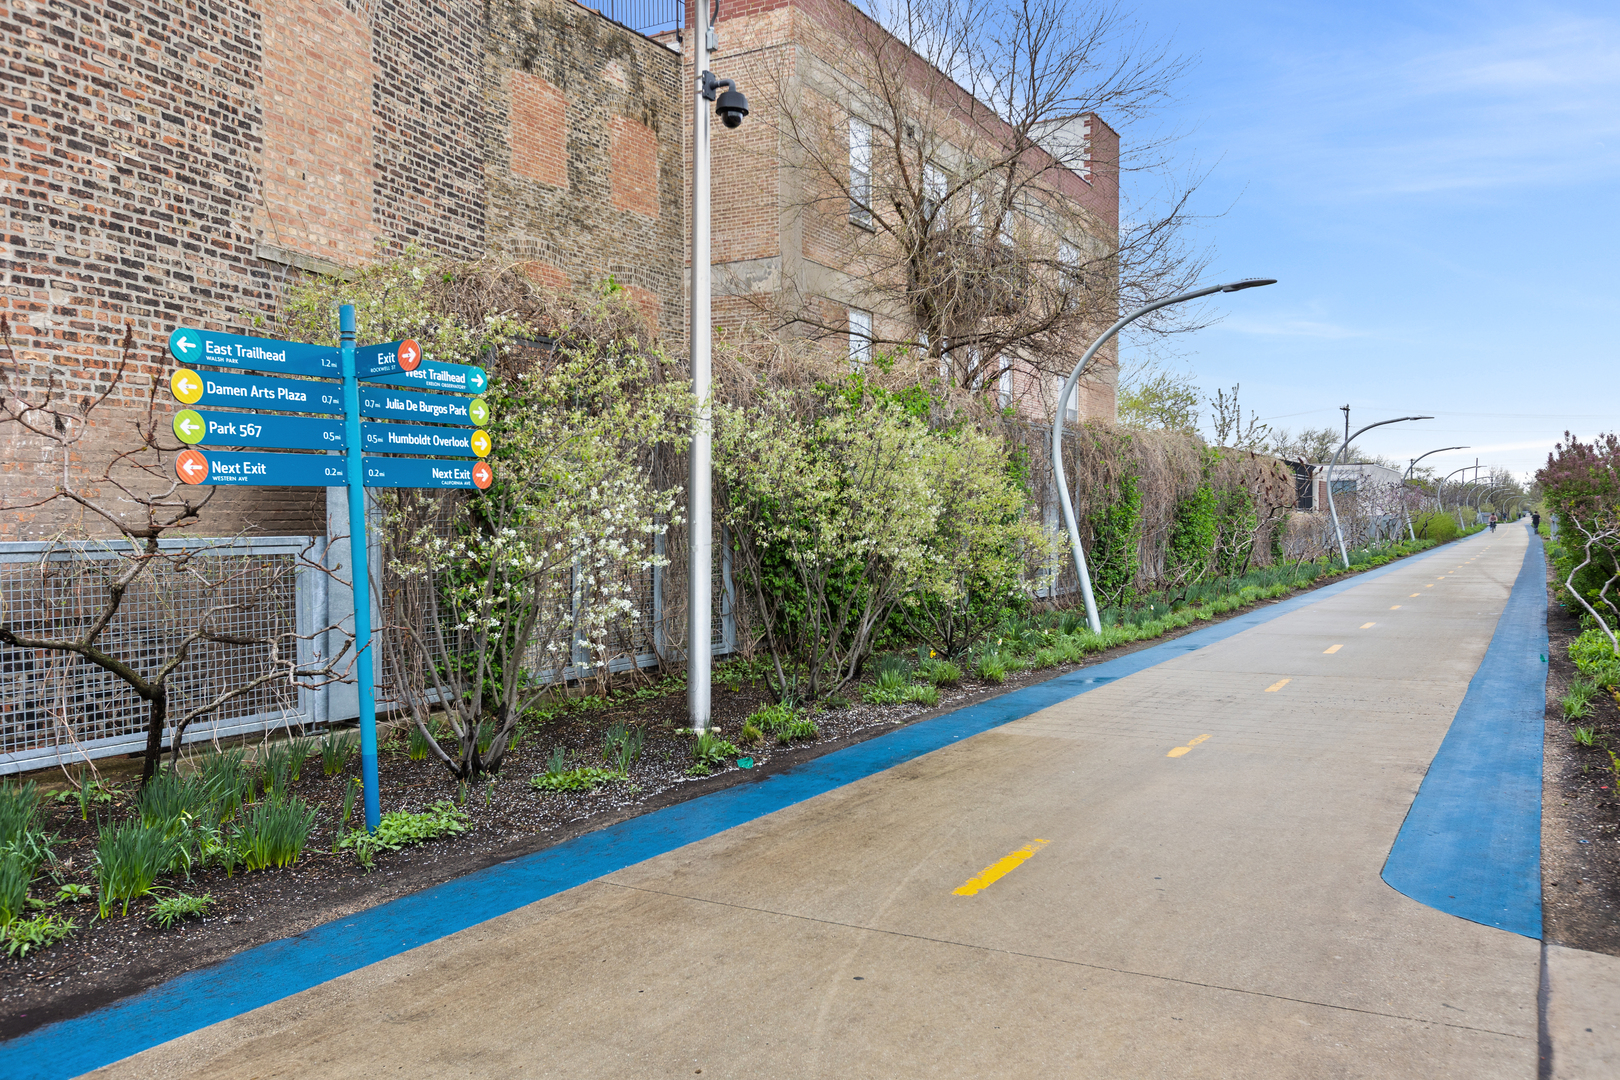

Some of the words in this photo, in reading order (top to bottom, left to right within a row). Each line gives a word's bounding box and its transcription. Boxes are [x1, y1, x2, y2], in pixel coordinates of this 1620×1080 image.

[206, 341, 232, 356] East
[235, 344, 286, 362] Trailhead
[378, 352, 395, 364] Exit
[430, 368, 466, 383] Trailhead
[207, 382, 247, 396] Damen
[251, 385, 275, 399] Arts
[278, 388, 306, 401] Plaza
[386, 398, 404, 411] Julia
[406, 401, 418, 412] De
[420, 403, 448, 416] Burgos
[449, 405, 467, 416] Park
[209, 421, 236, 435] Park
[240, 424, 262, 437] 567
[388, 433, 431, 445] Humboldt
[433, 435, 469, 448] Overlook
[212, 461, 240, 473] Next
[244, 462, 266, 474] Exit
[432, 468, 452, 479] Next
[454, 469, 470, 479] Exit
